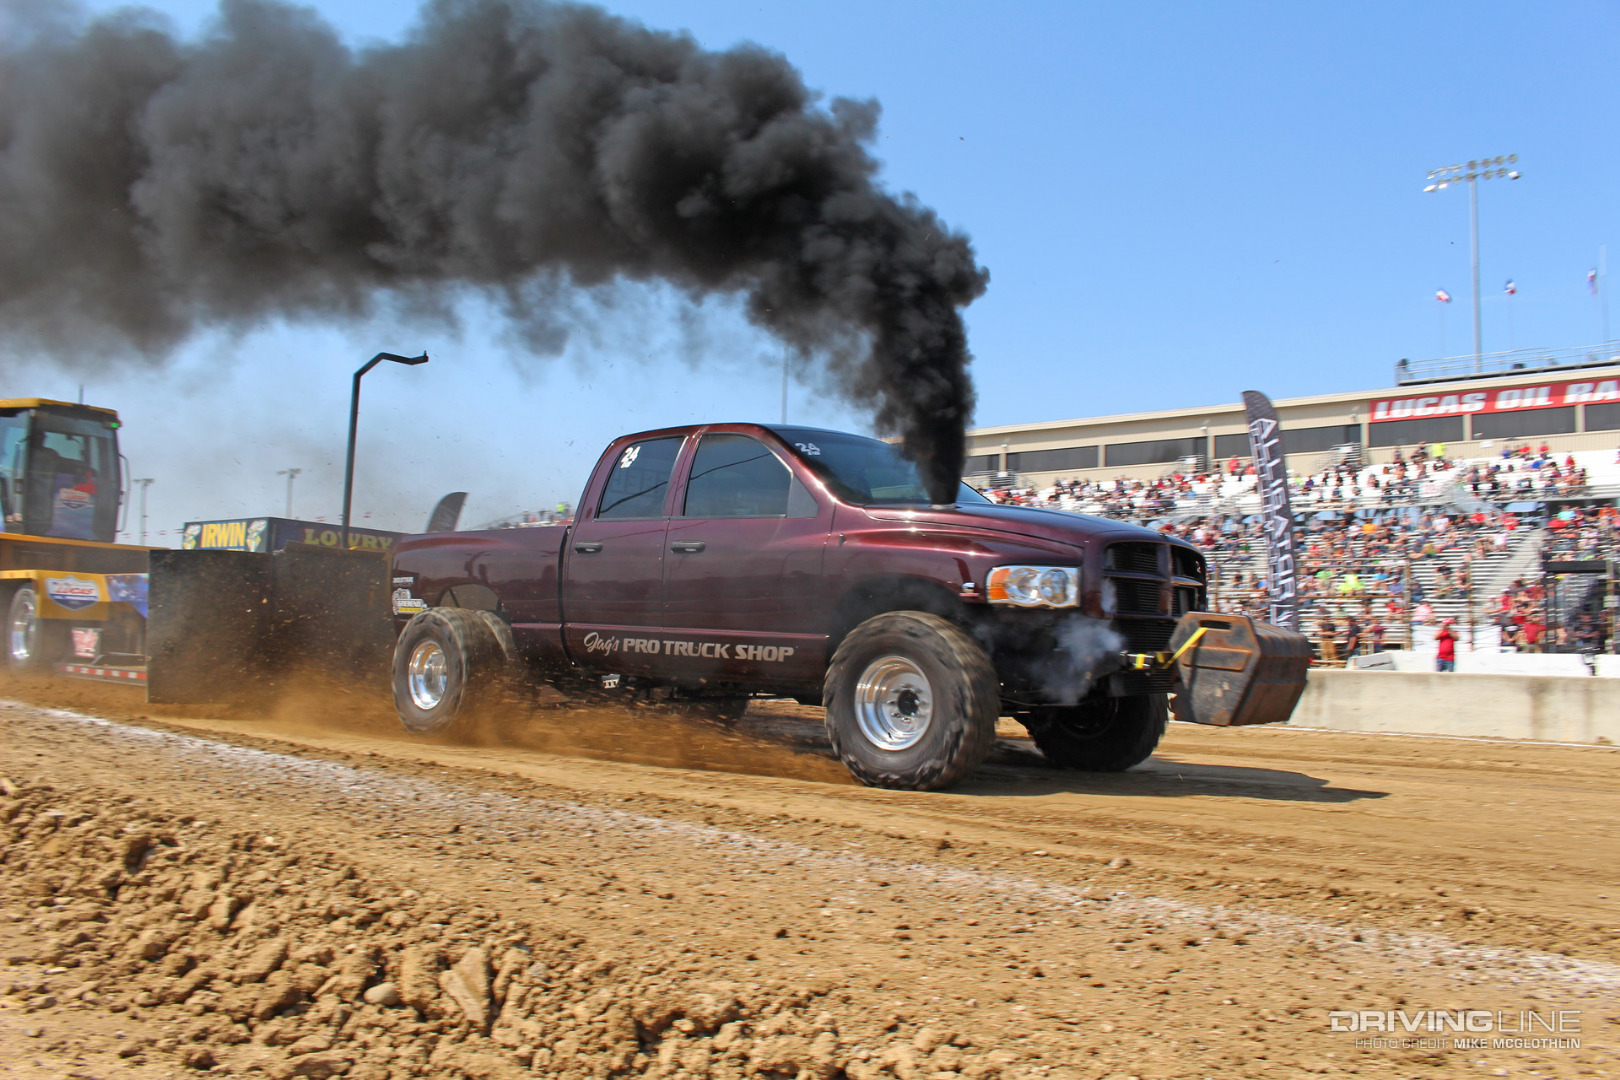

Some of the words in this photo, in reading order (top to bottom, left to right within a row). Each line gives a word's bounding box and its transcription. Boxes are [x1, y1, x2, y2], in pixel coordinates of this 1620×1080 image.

[1374, 393, 1487, 420] LUCAS
[1495, 386, 1553, 409] OIL
[1249, 418, 1296, 600] ALLIGATOR
[201, 522, 246, 547] IRWIN
[623, 638, 660, 654] PRO
[663, 640, 730, 659] TRUCK
[735, 644, 795, 662] SHOP
